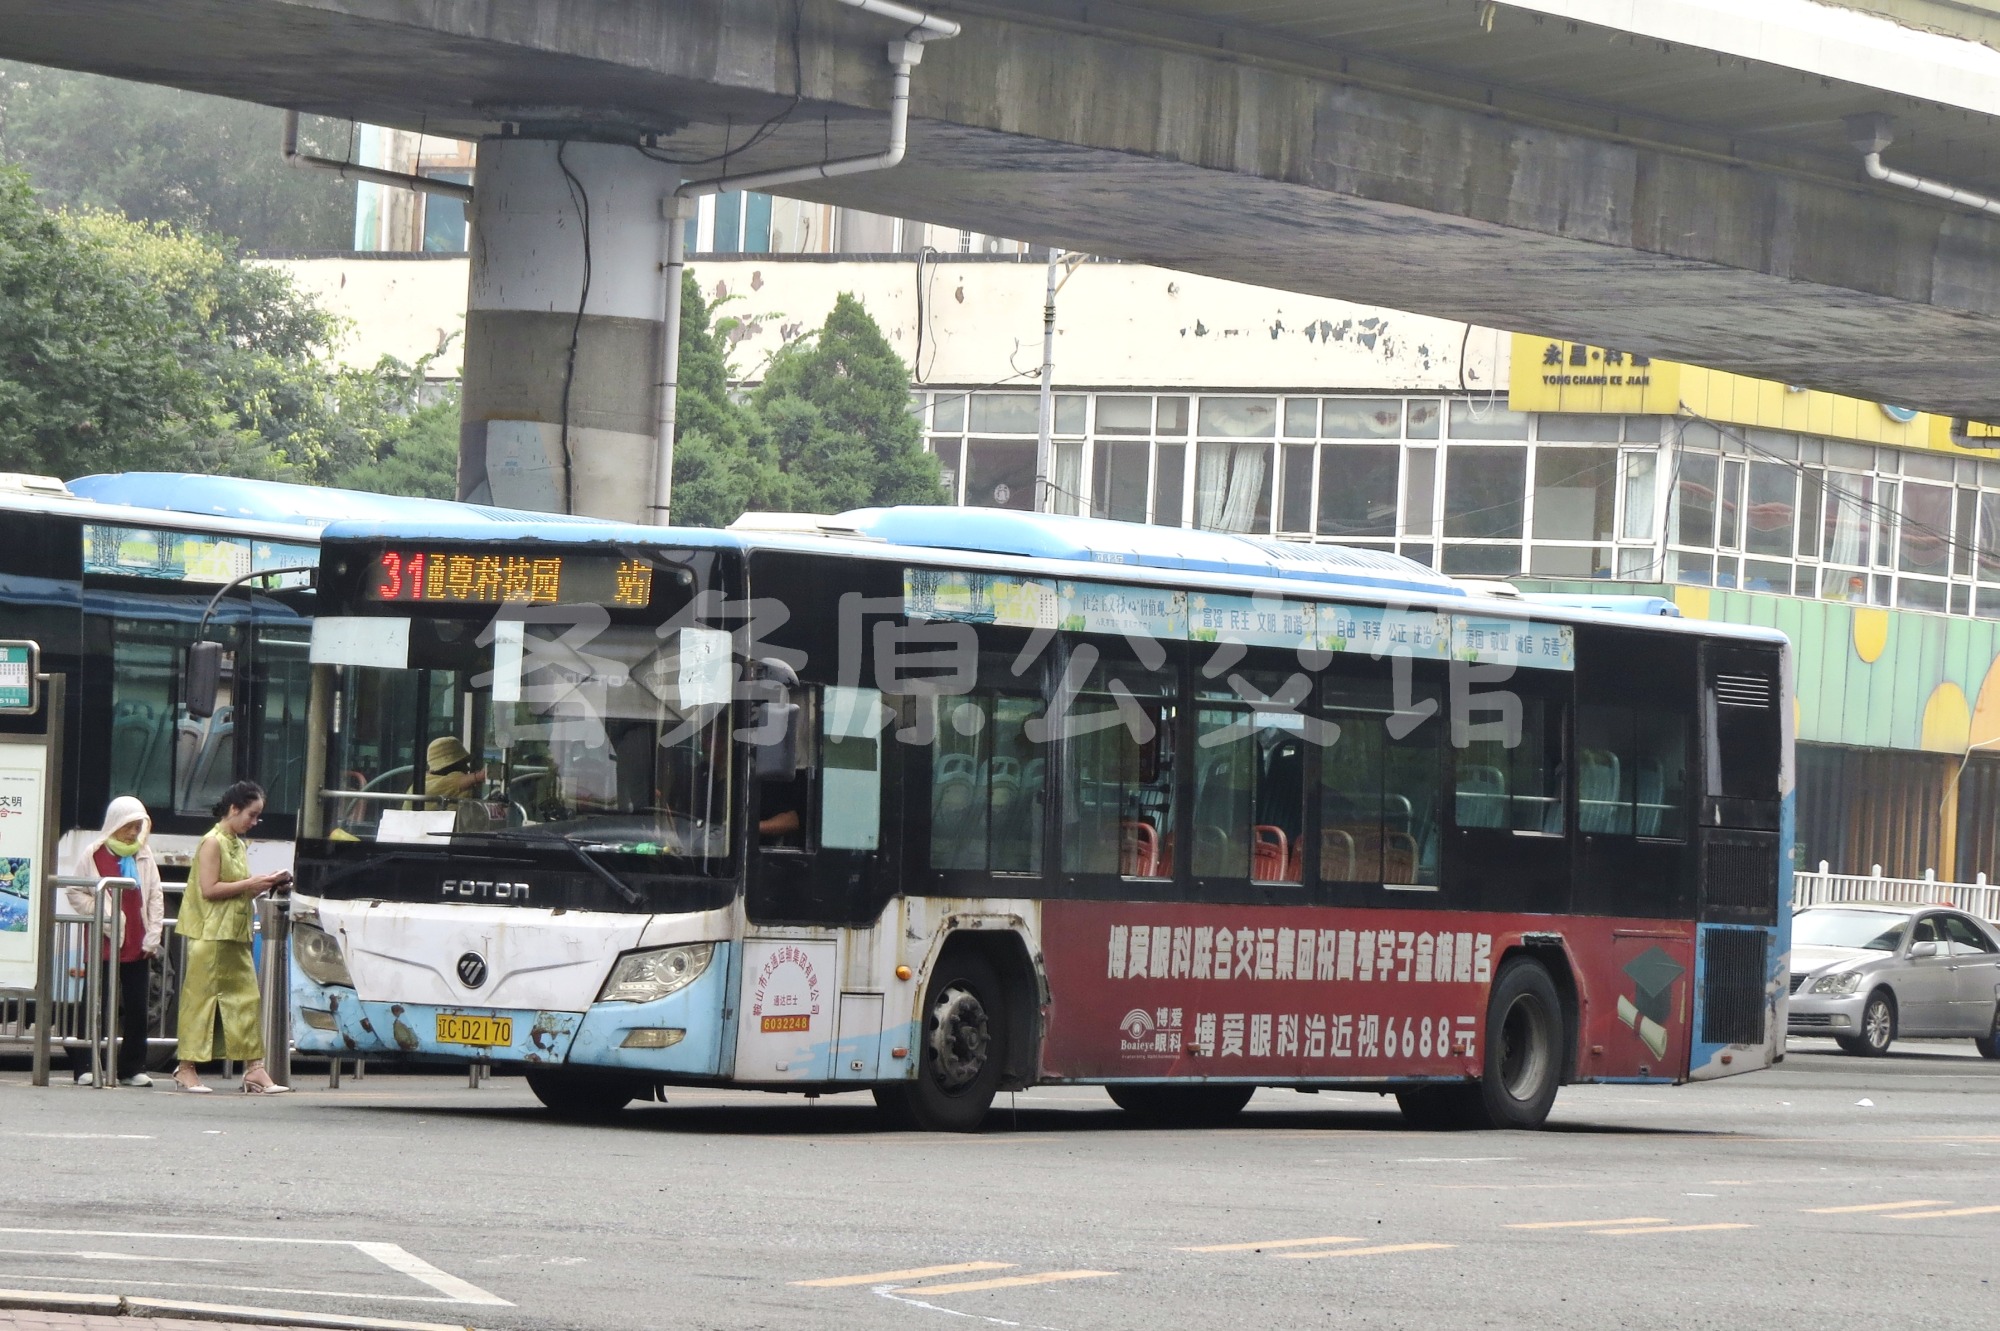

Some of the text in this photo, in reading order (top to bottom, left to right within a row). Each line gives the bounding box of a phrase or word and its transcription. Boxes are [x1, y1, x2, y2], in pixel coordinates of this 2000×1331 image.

[1542, 375, 1650, 386] YONG CHANG KE JIAN
[380, 553, 424, 599] 31
[614, 559, 652, 604] 站
[1082, 589, 1166, 618] 社会主义核心价值观
[1202, 607, 1303, 635] 富强 民主 文明 和谐
[1336, 617, 1431, 645] 自由 平等 公正 法治
[1465, 629, 1560, 657] 爱国 敬业 诚信 友善
[0, 796, 22, 807] 文明
[442, 880, 530, 899] FOTON
[1107, 924, 1492, 983] 博爱眼科联合交运集团祝高考学子金榜题名
[753, 945, 820, 1016] 鞍山市交通运输集团有限公司
[773, 995, 798, 1006] 通达巴士
[764, 1017, 807, 1030] 6032248
[1156, 1007, 1183, 1028] 博爱
[1121, 1038, 1155, 1053] Boaieye
[1155, 1032, 1182, 1053] 眼科
[1194, 1012, 1476, 1058] 博爱眼科治近视6688元
